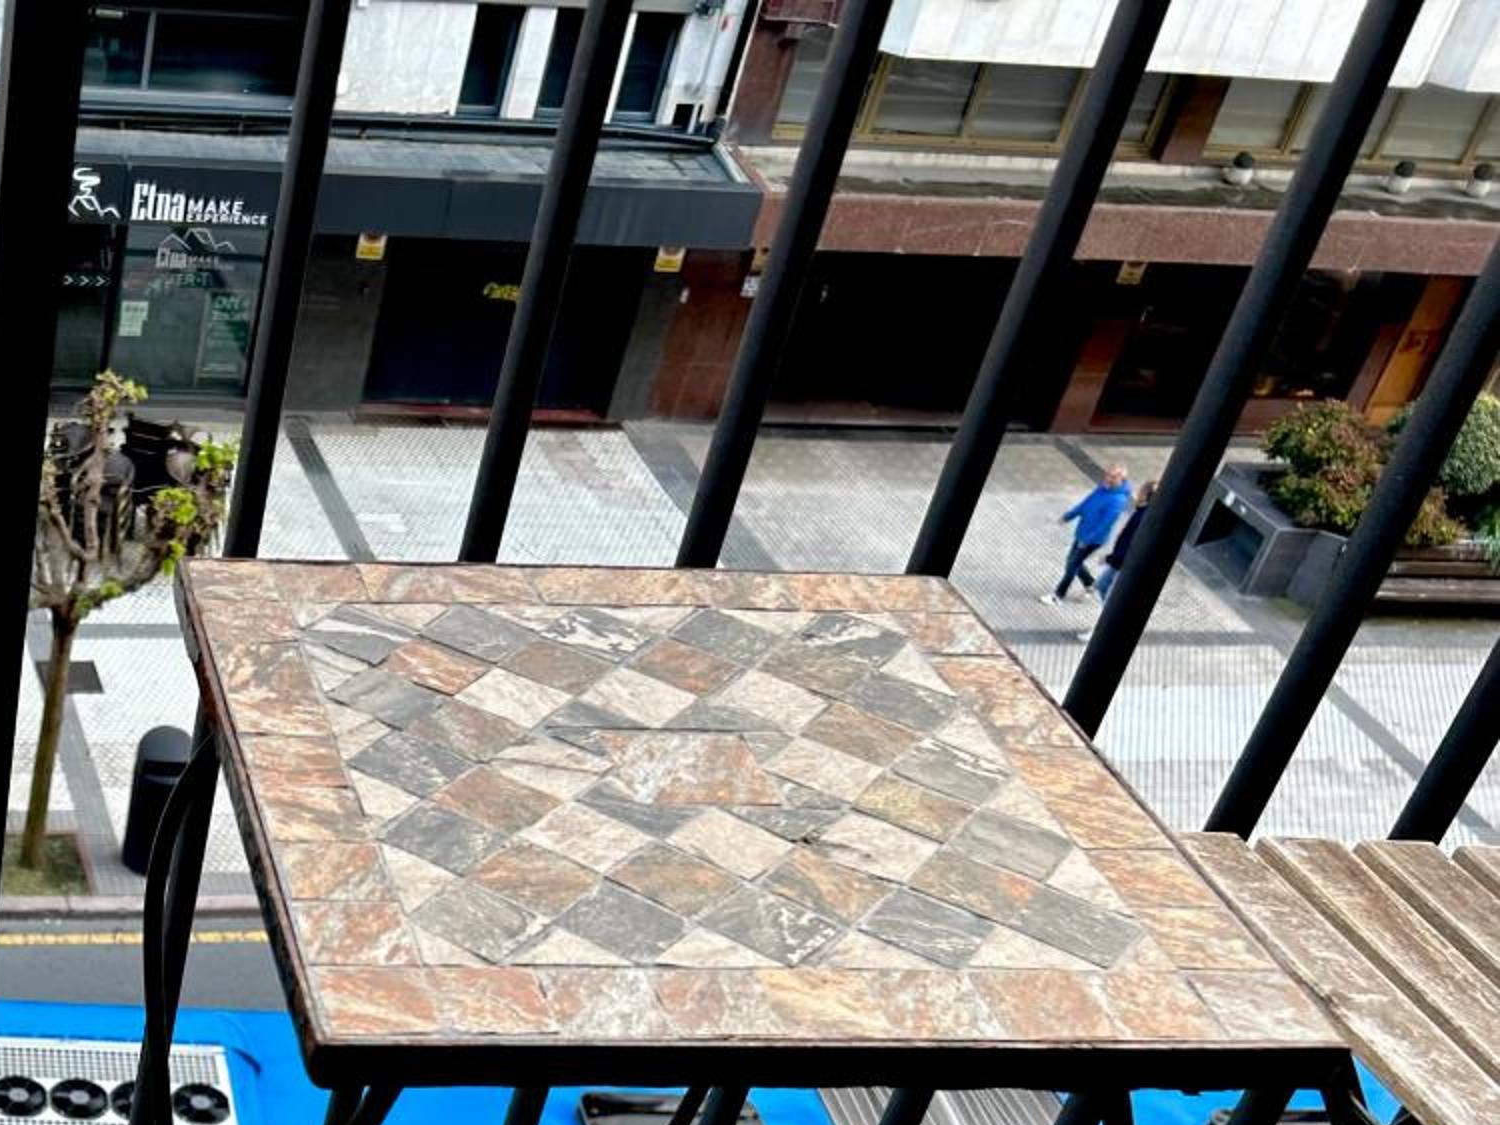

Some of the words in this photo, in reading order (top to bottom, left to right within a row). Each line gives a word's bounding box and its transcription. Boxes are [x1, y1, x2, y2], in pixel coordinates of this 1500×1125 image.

[131, 182, 186, 222] Etna
[187, 199, 244, 215] MAKE
[186, 214, 269, 225] EXPERIENCE
